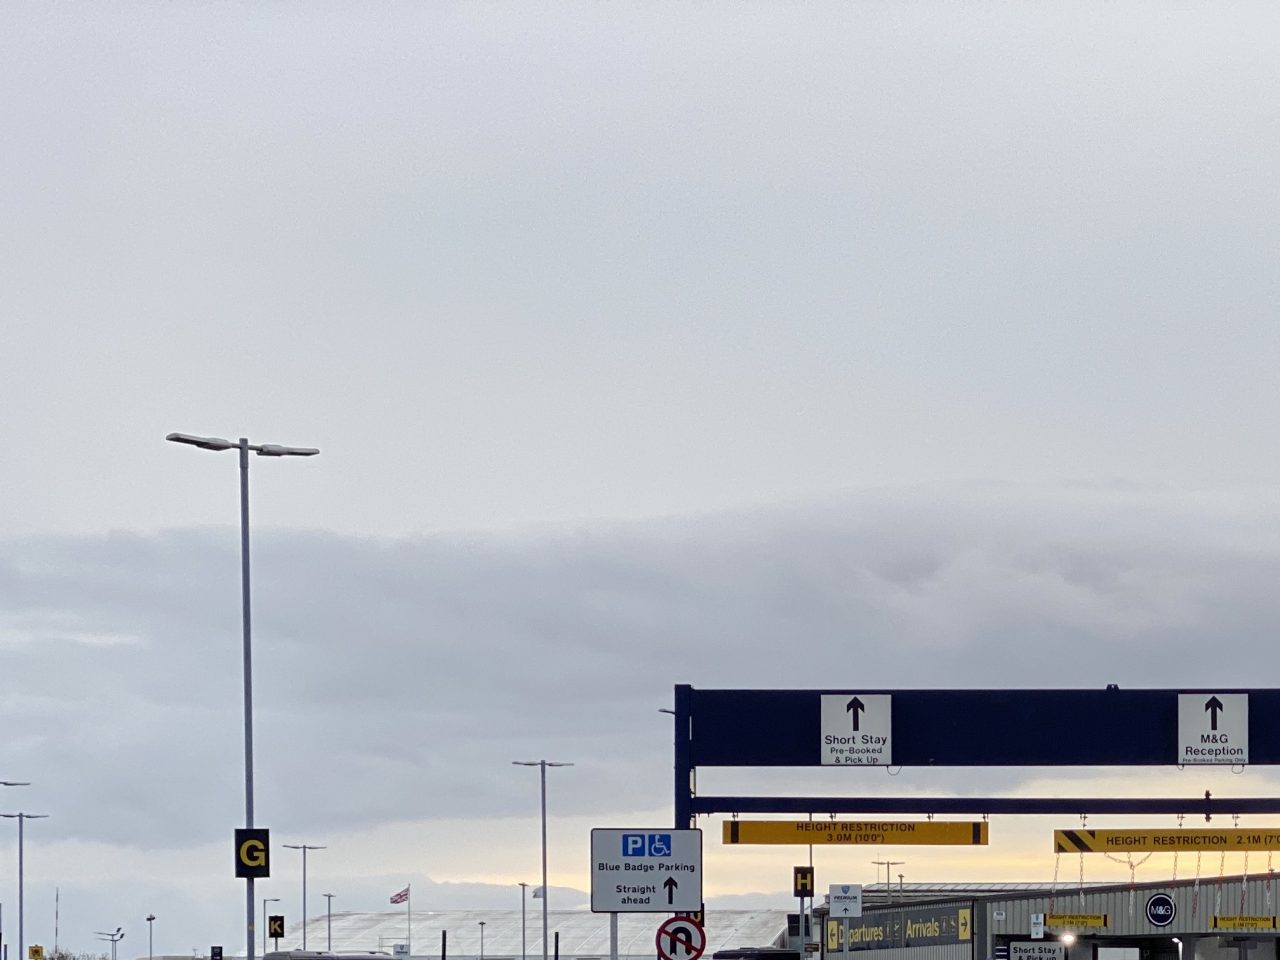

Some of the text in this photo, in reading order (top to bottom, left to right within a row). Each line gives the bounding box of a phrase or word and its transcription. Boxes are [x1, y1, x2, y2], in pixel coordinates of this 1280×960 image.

[824, 734, 888, 746] Short Stay
[1200, 733, 1229, 744] M&G
[830, 746, 883, 754] Pre-Booked
[1185, 746, 1244, 757] Reception
[834, 756, 879, 765] & Pick Up
[796, 823, 915, 832] HEIGHT RESTRICTION
[826, 833, 852, 843] 3.0M
[1106, 836, 1148, 846] HEIGHT
[1153, 835, 1228, 845] RESTRICTION
[1236, 834, 1261, 845] 2.1M
[627, 836, 642, 855] P
[239, 839, 266, 867] G
[598, 862, 695, 873] Blue Badge Parking
[796, 873, 811, 891] H
[615, 885, 656, 895] Straight
[621, 896, 650, 905] ahead
[1150, 905, 1171, 915] M&G
[270, 920, 283, 933] K
[905, 917, 940, 939] Arrivals
[838, 924, 884, 946] Dpartures
[1013, 946, 1035, 954] Short
[1038, 946, 1056, 955] Stay
